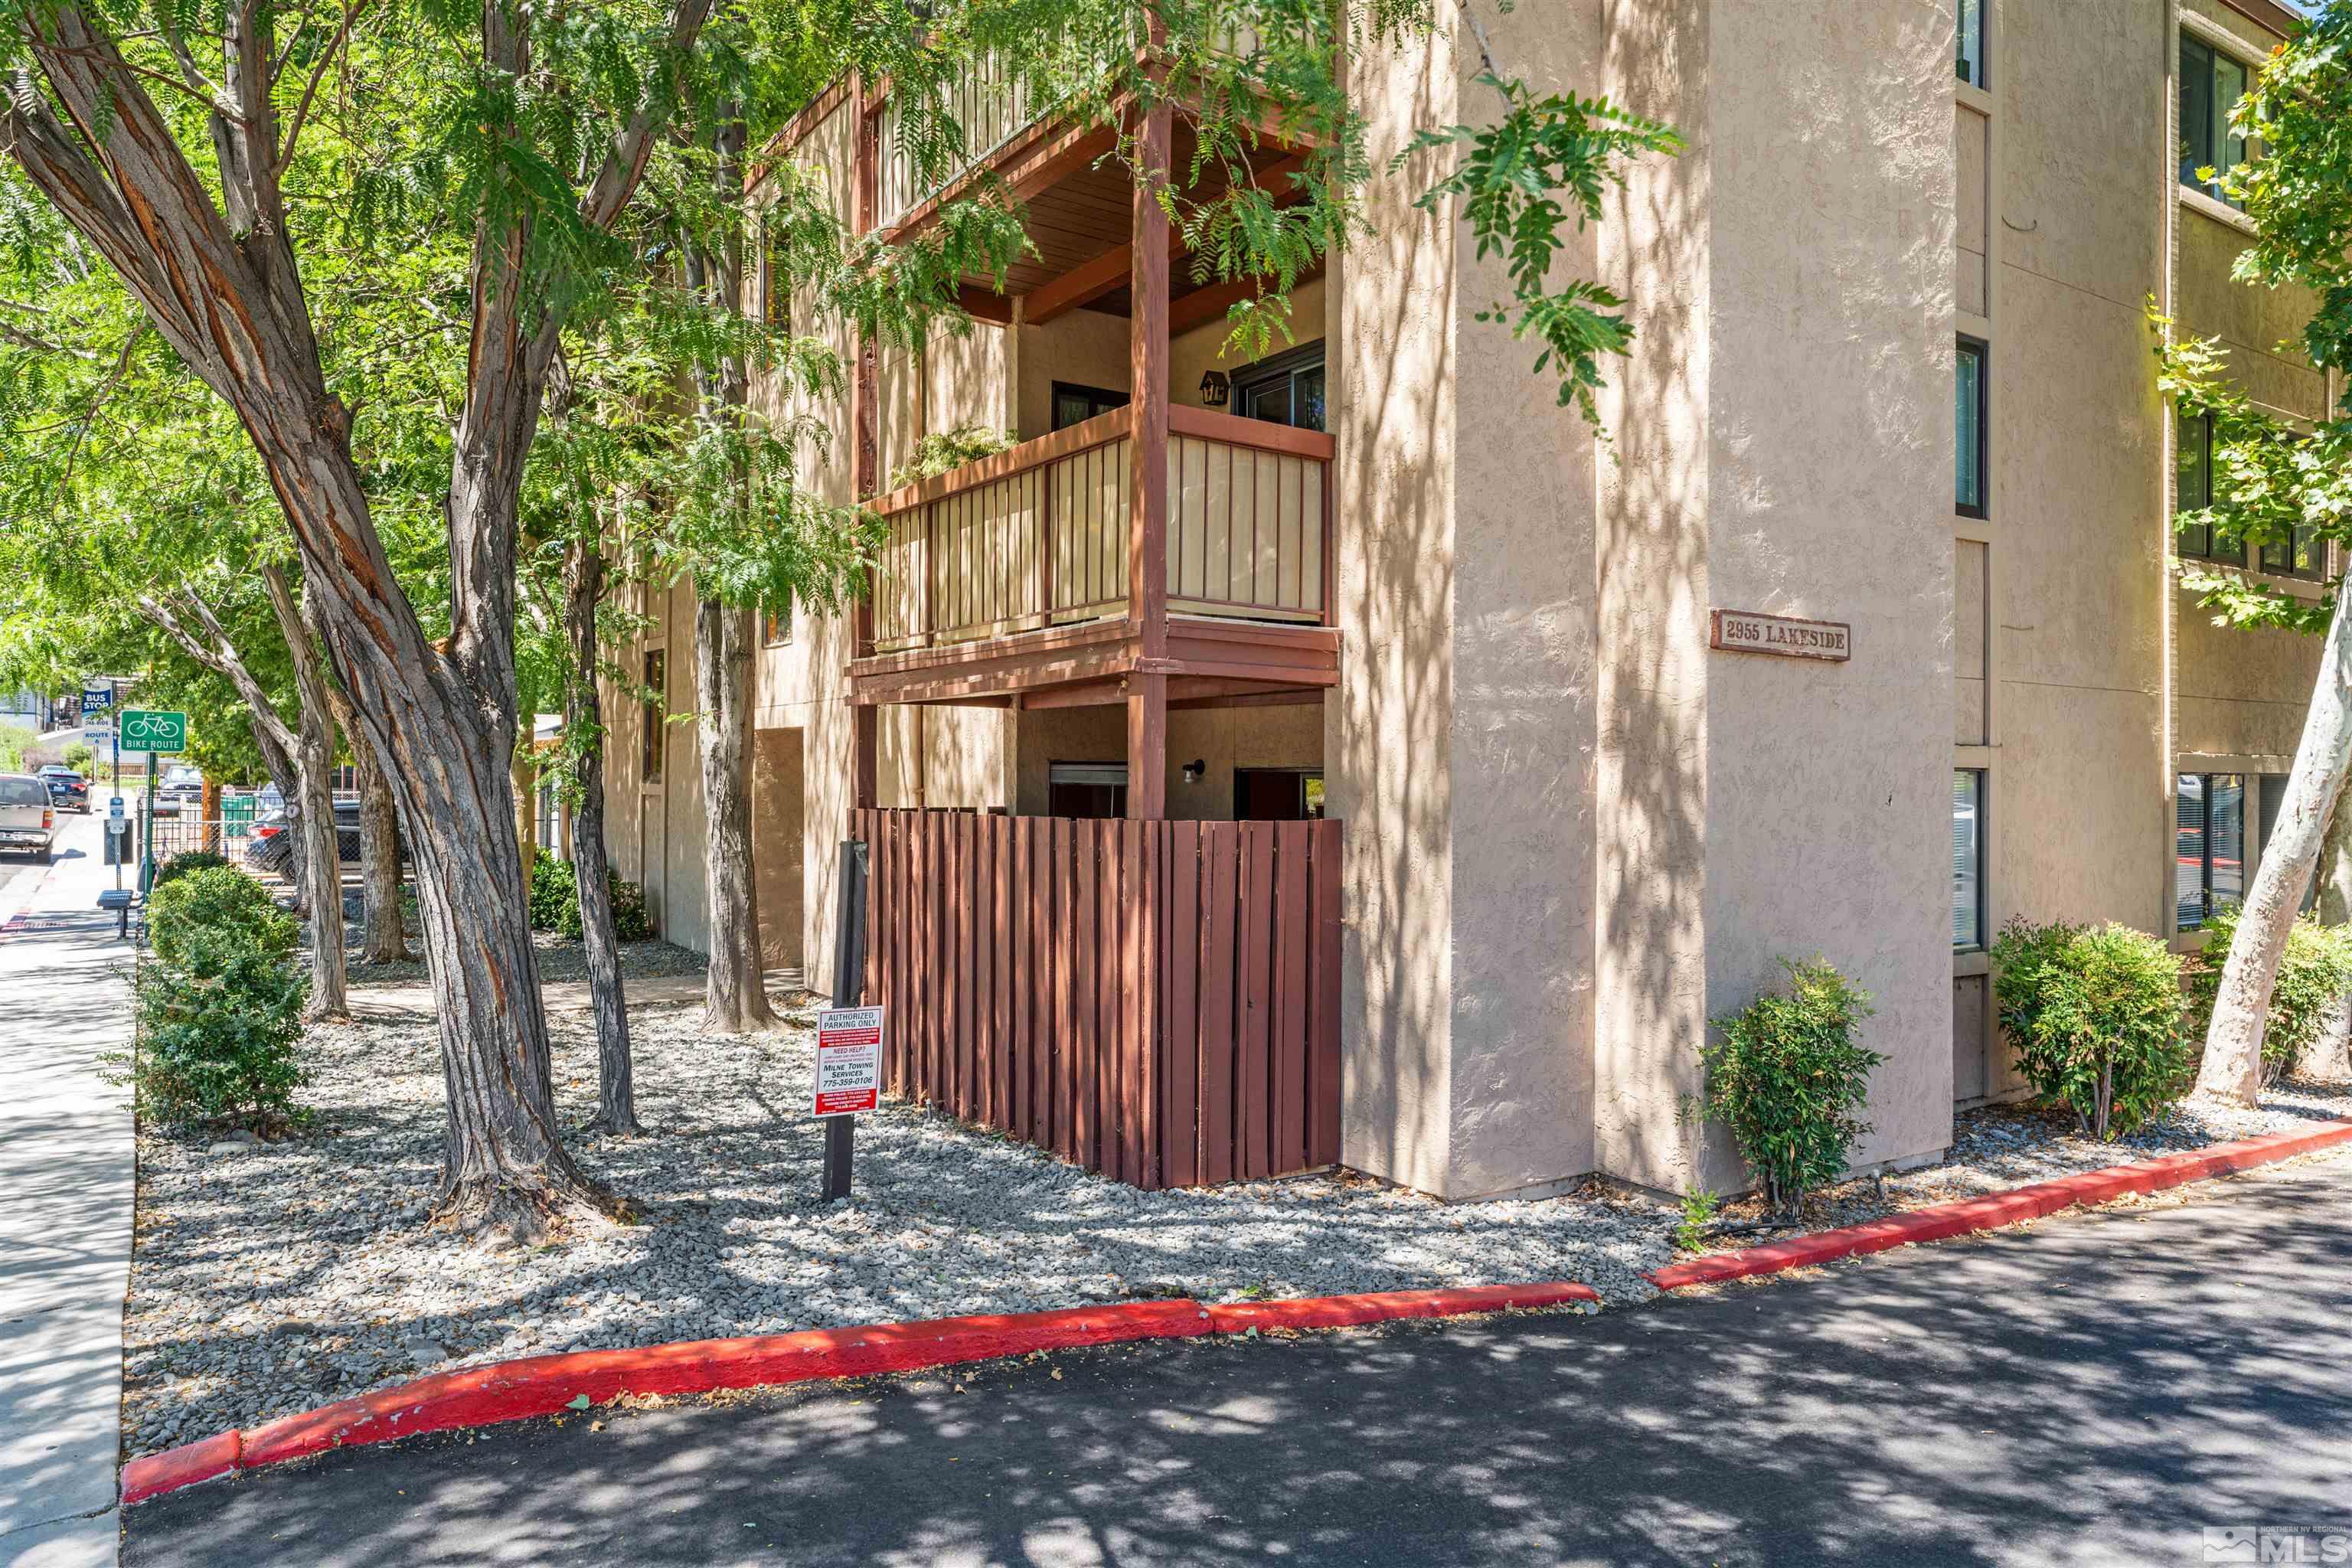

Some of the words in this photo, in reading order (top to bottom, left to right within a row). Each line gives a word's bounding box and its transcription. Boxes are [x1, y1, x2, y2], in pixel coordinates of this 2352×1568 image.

[1726, 620, 1760, 641] 2955
[1766, 626, 1845, 649] LAKESIDE
[151, 740, 179, 749] ROUTE
[828, 1012, 874, 1021] AUTHORIZED
[822, 1076, 873, 1087] 775-359-0106
